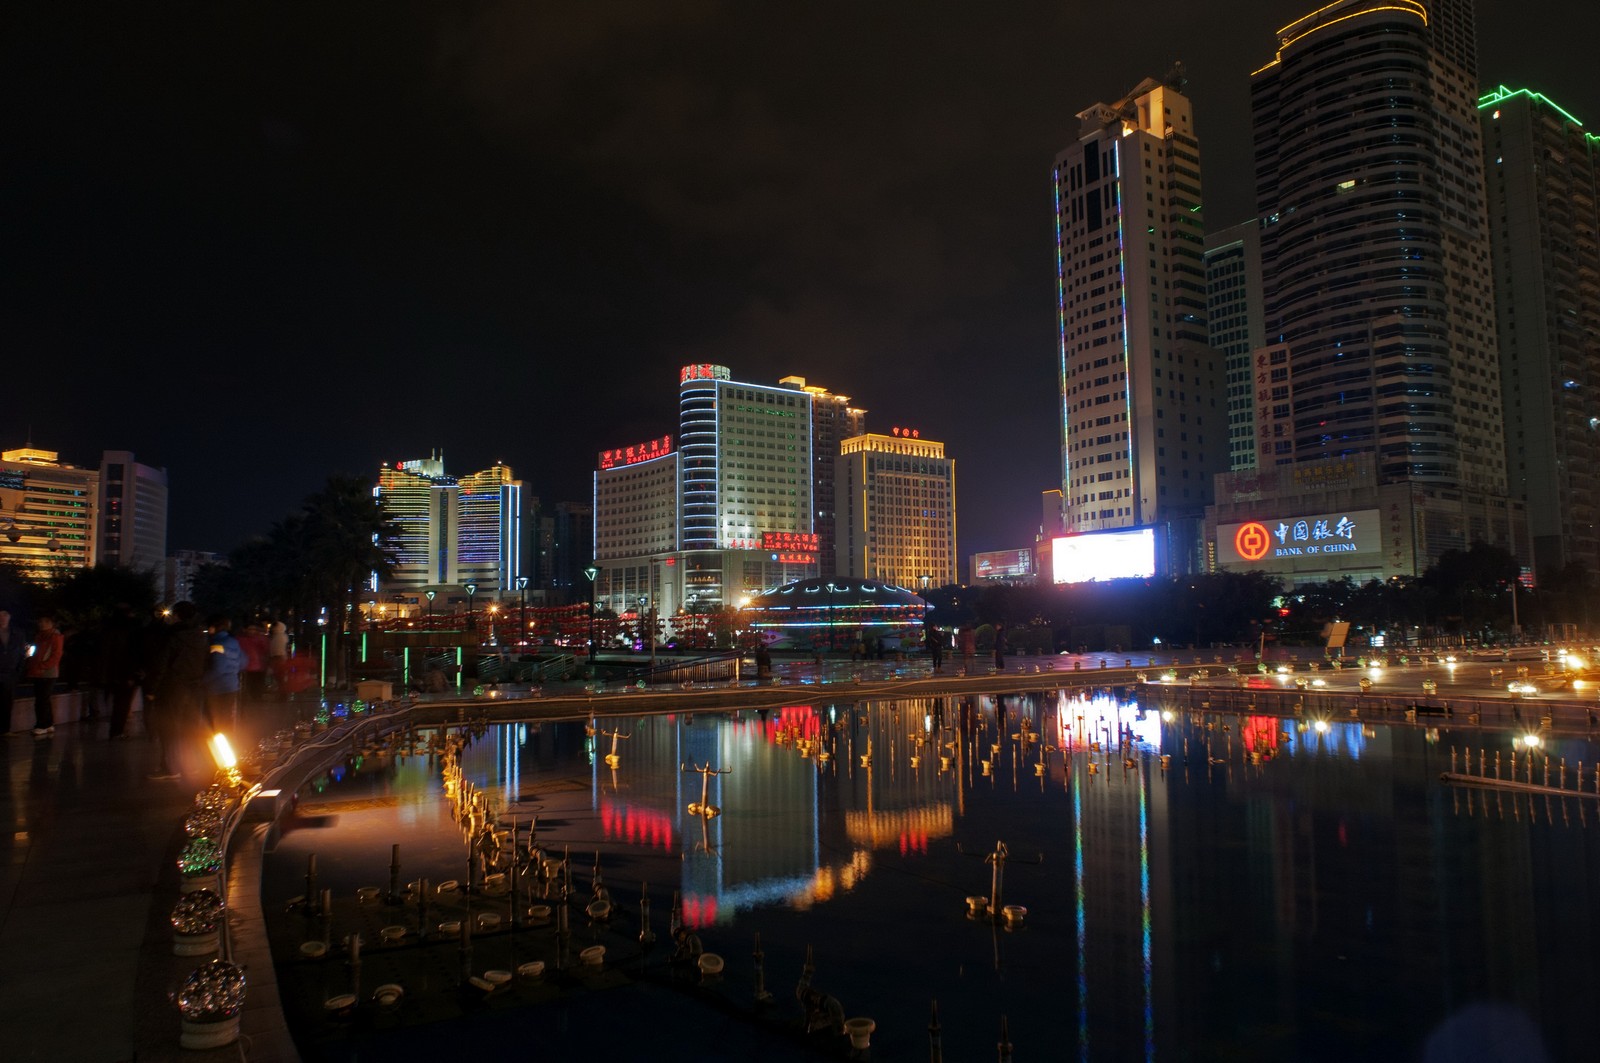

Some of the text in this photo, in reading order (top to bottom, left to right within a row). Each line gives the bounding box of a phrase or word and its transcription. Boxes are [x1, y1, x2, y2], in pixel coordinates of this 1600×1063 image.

[1276, 543, 1357, 556] BANK OF CHINA
